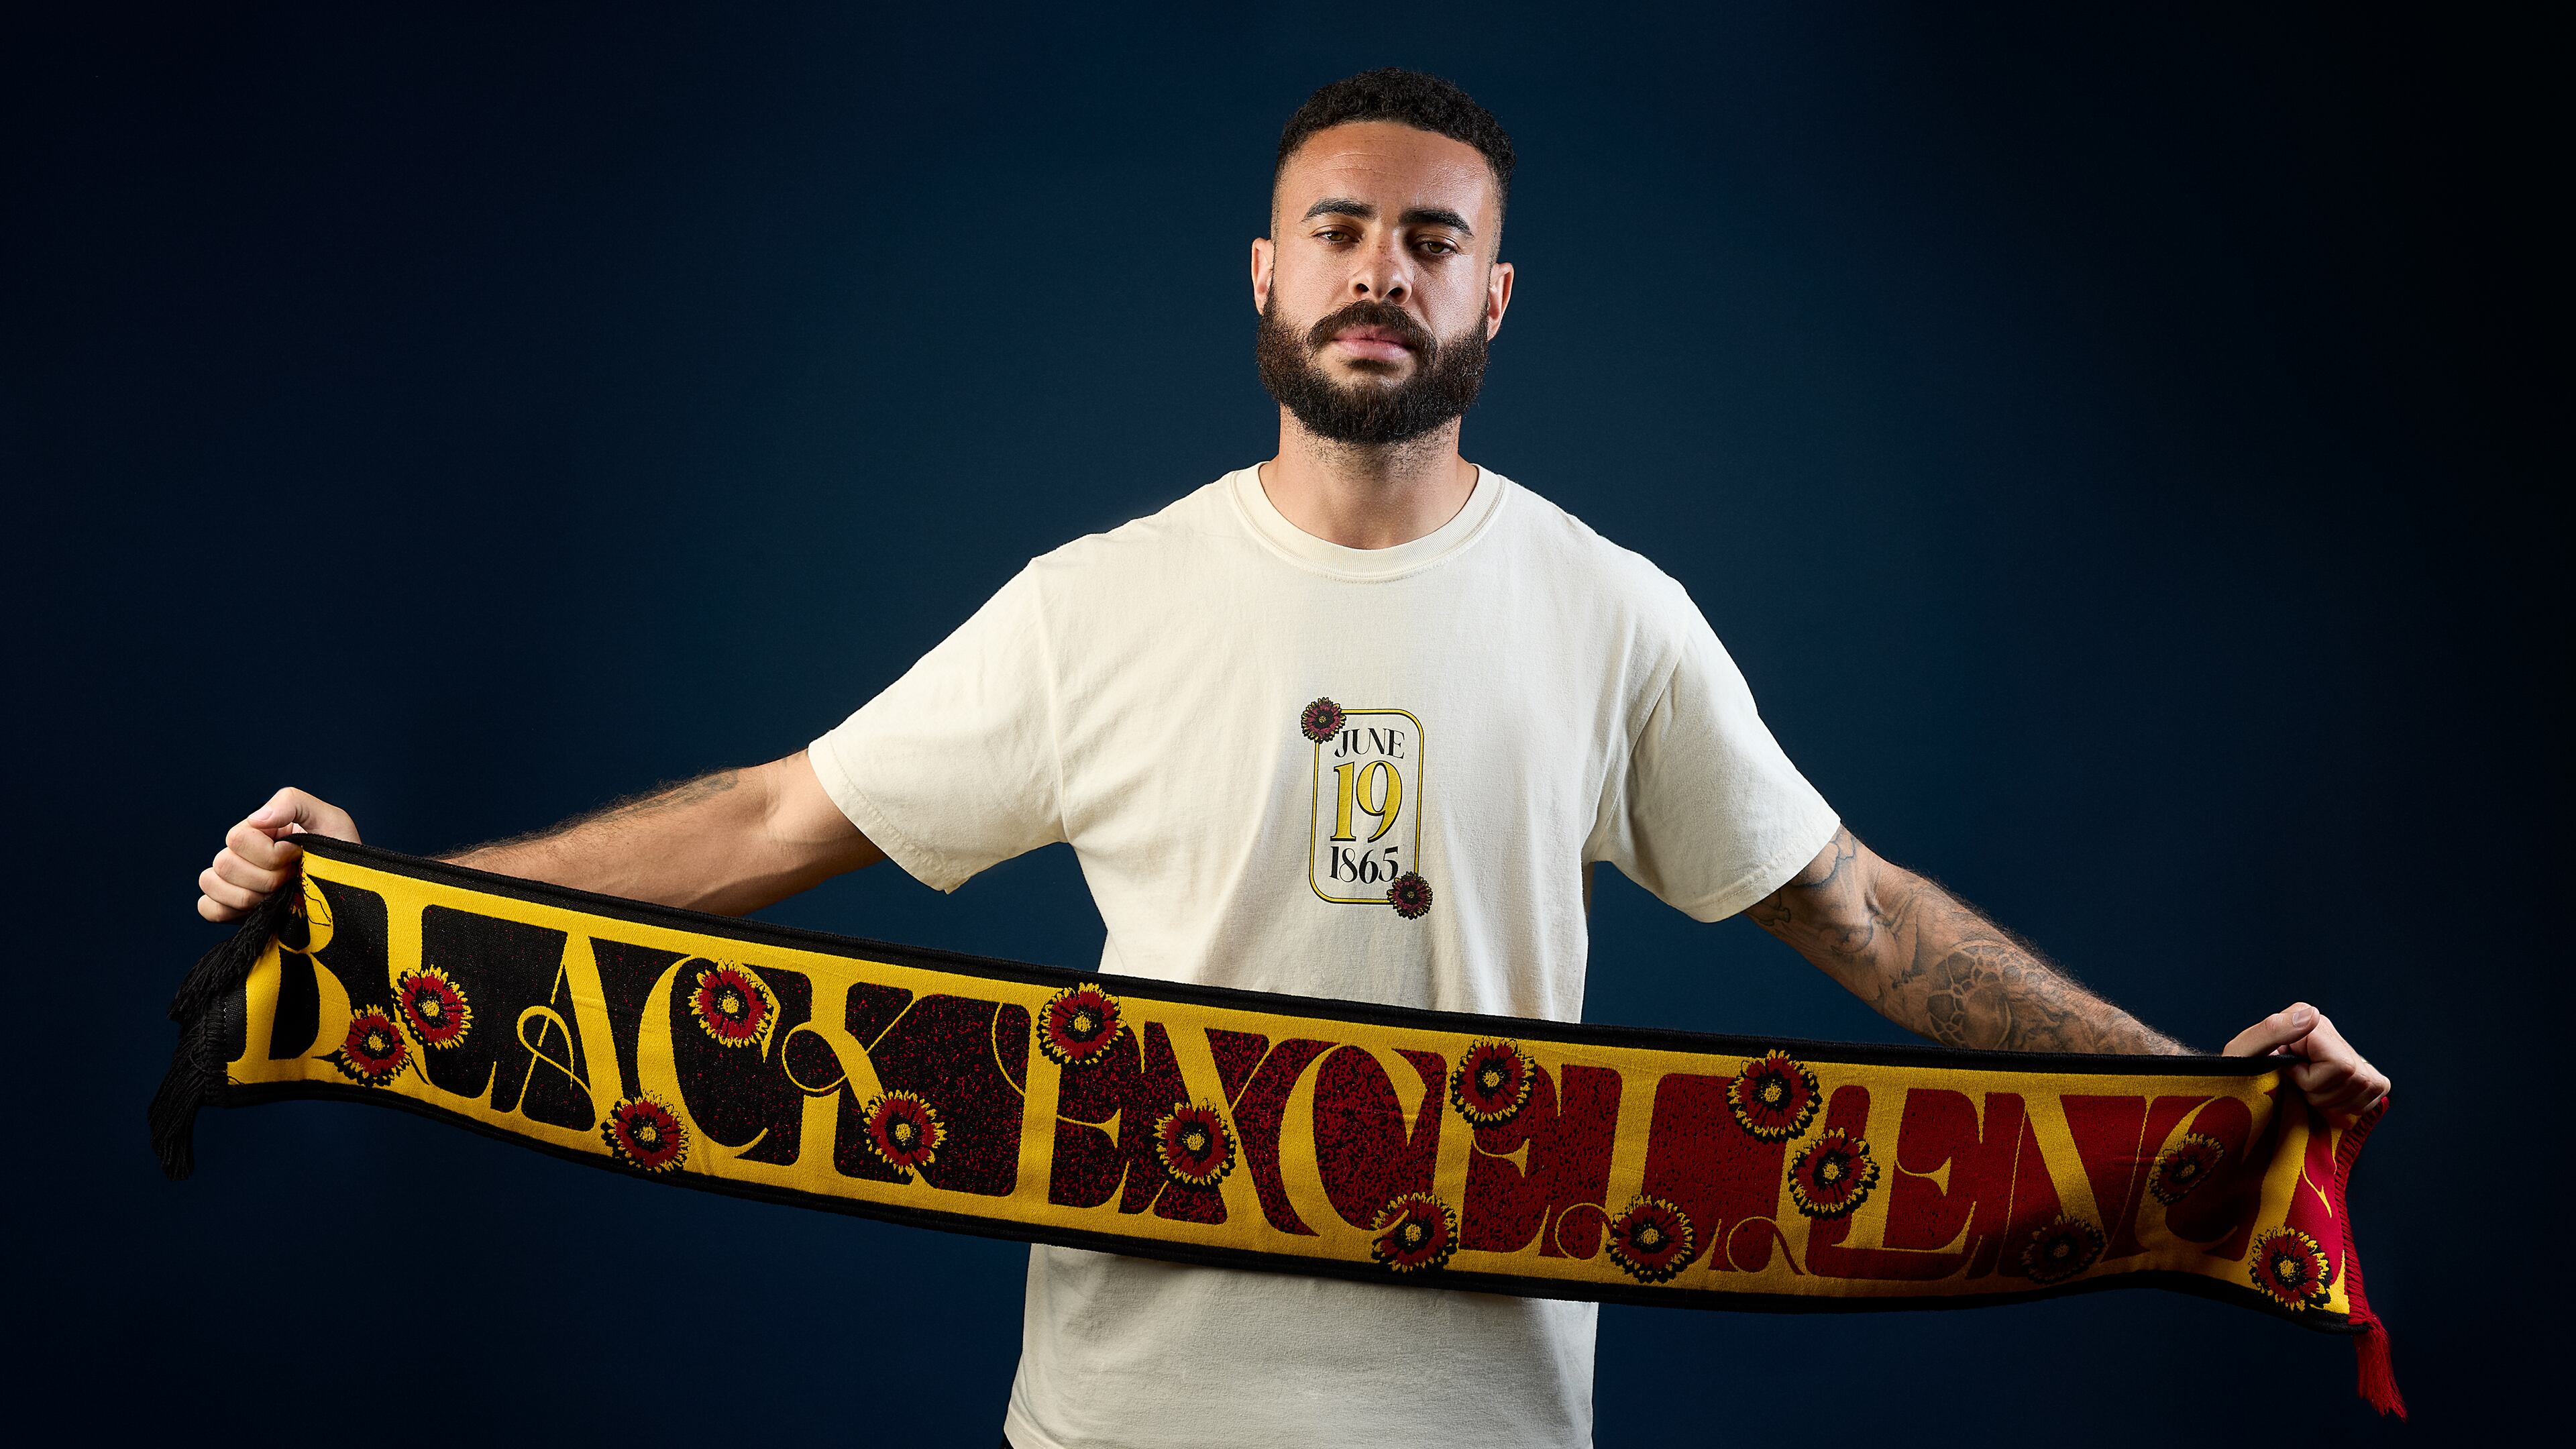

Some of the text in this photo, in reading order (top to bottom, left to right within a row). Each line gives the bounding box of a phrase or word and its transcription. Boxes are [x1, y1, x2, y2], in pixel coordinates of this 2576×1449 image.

[1334, 727, 1405, 759] JUNE
[1330, 760, 1403, 843] 19
[1329, 846, 1399, 884] 1865
[227, 853, 939, 1197] BLACK
